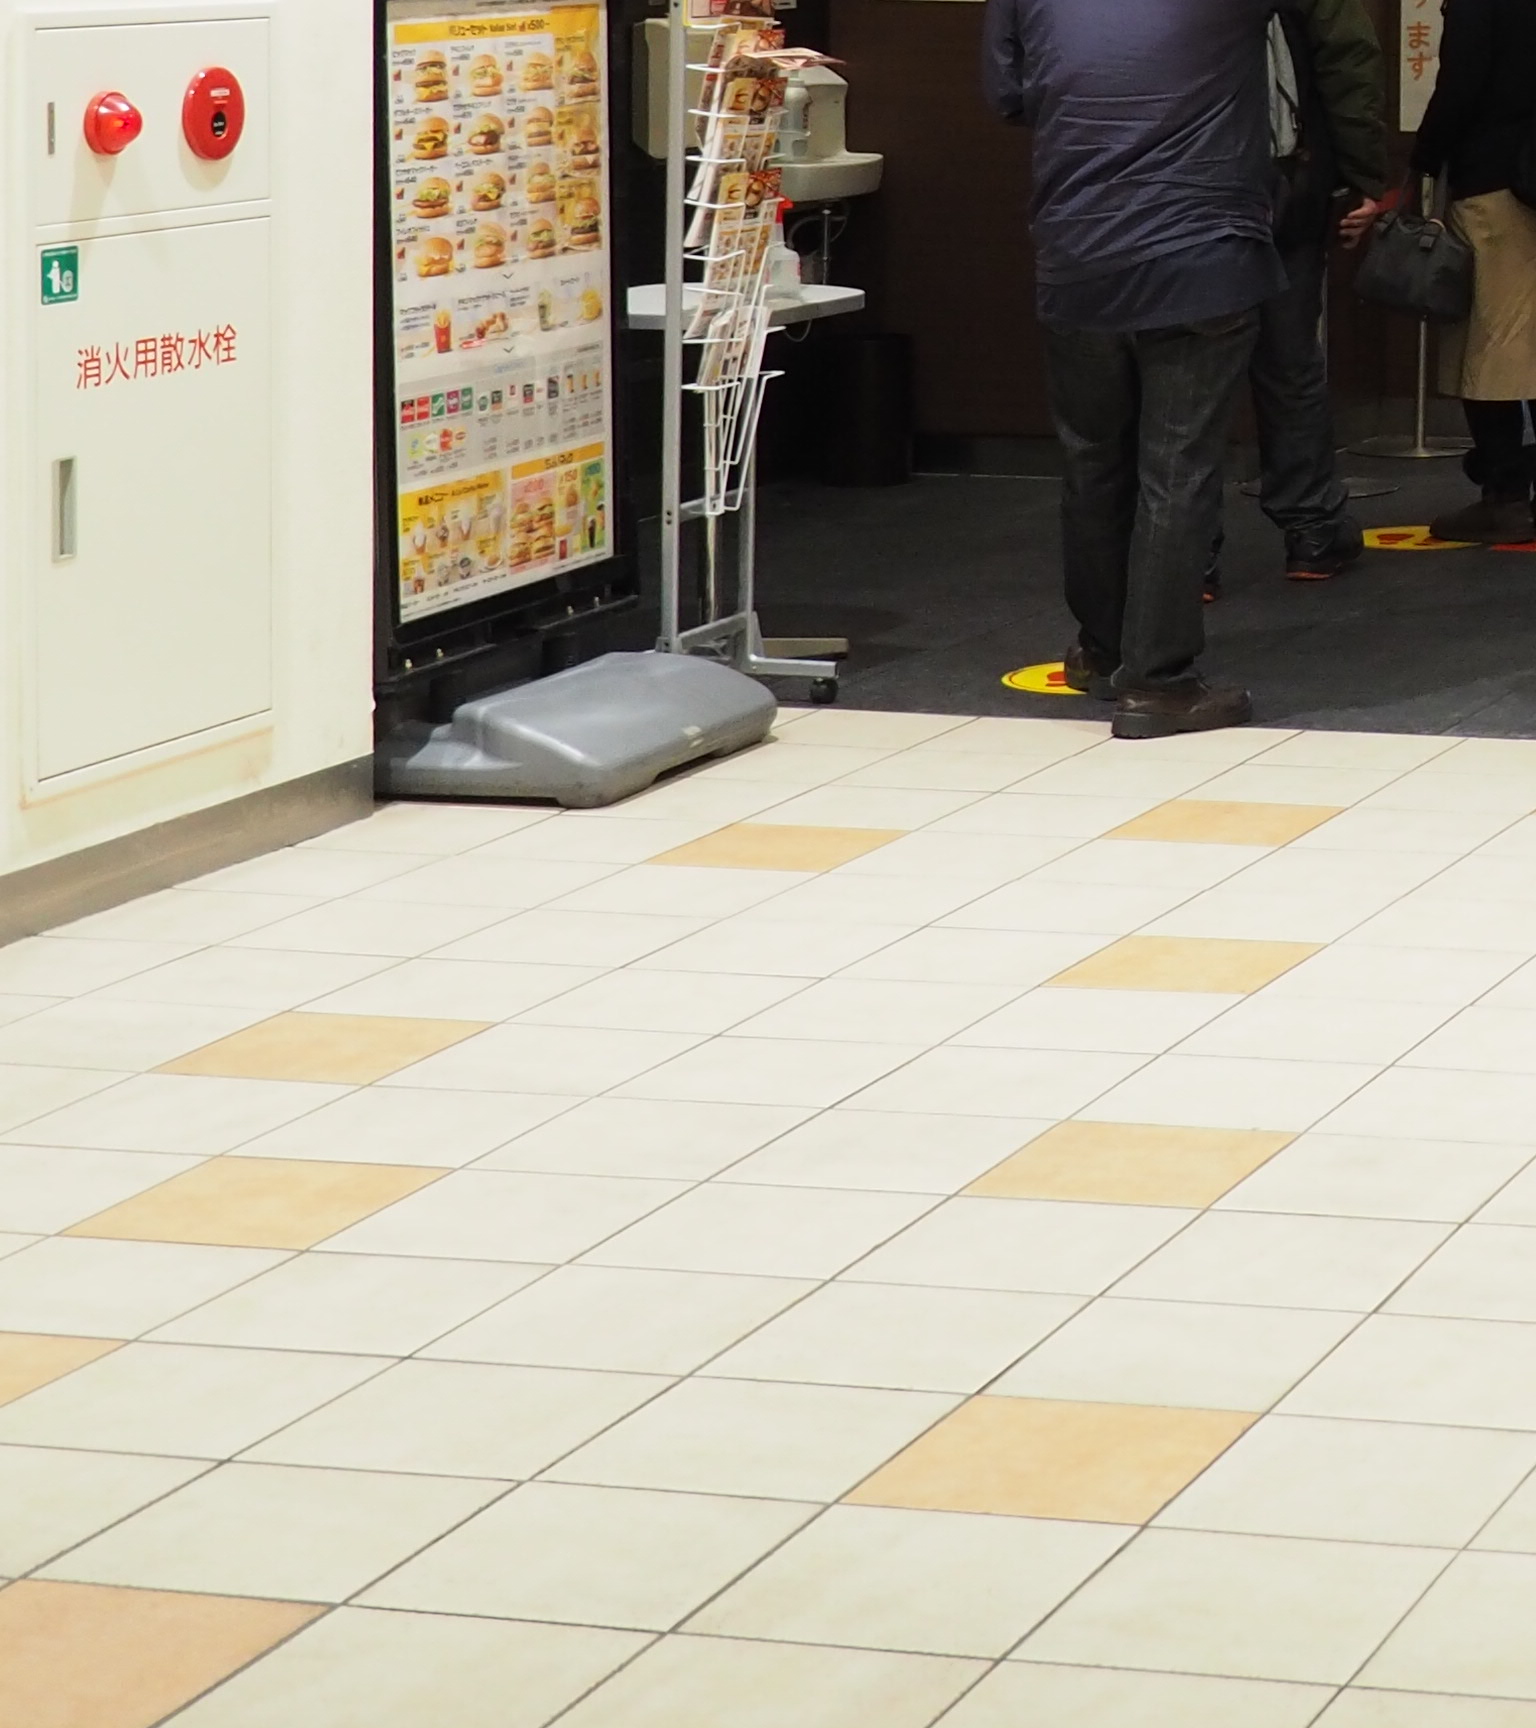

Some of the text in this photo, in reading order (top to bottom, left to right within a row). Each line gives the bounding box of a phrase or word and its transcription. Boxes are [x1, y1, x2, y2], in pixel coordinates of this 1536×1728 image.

[77, 323, 237, 390] 消火用散水栓
